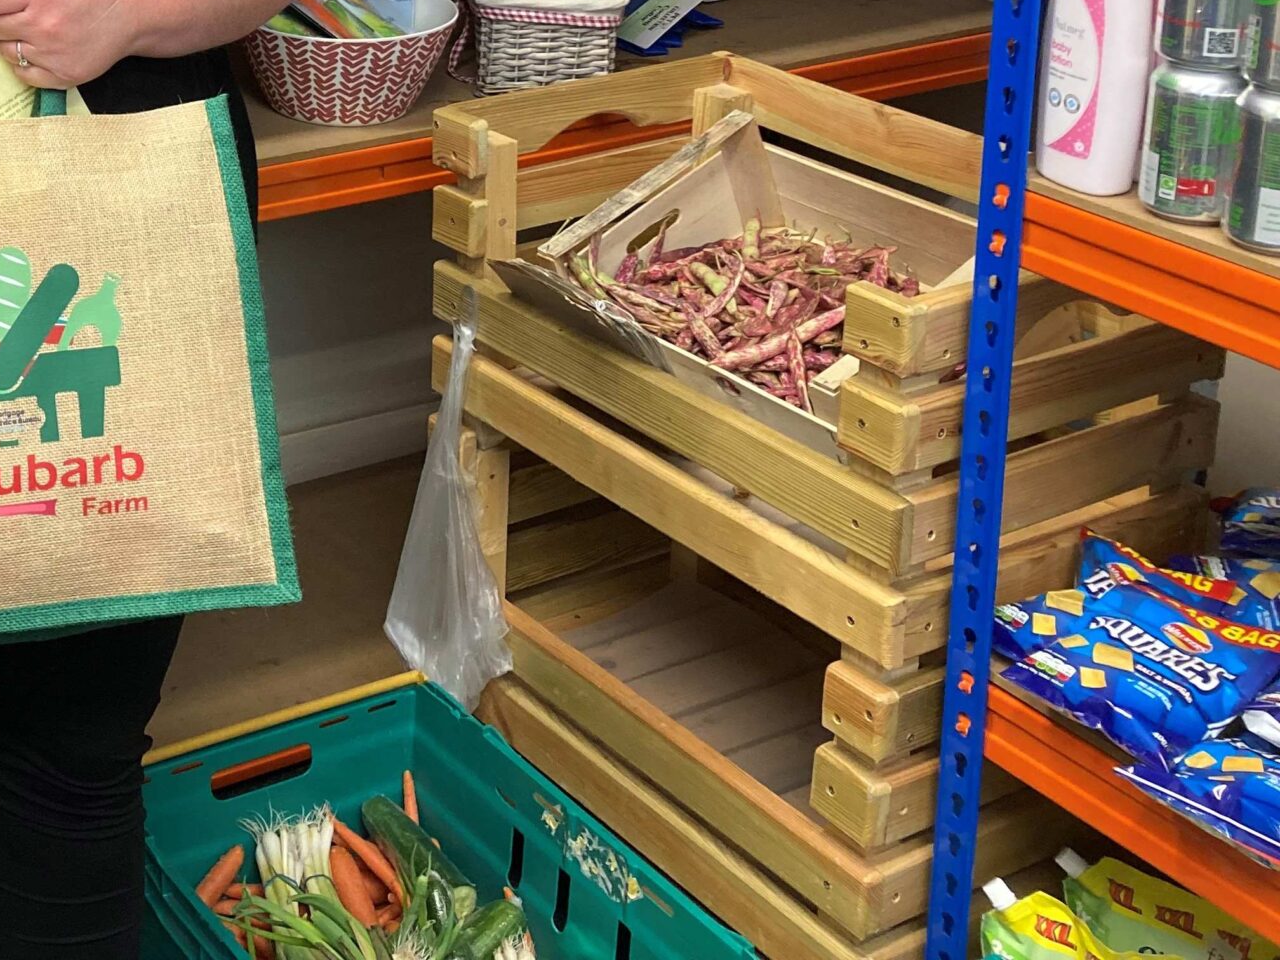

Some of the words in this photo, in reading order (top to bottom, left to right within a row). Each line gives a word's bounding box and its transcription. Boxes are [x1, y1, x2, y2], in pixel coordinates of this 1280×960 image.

[81, 496, 149, 517] Farm
[1221, 625, 1280, 648] BAG
[1089, 615, 1237, 691] SQUARES
[1034, 913, 1077, 952] XXL
